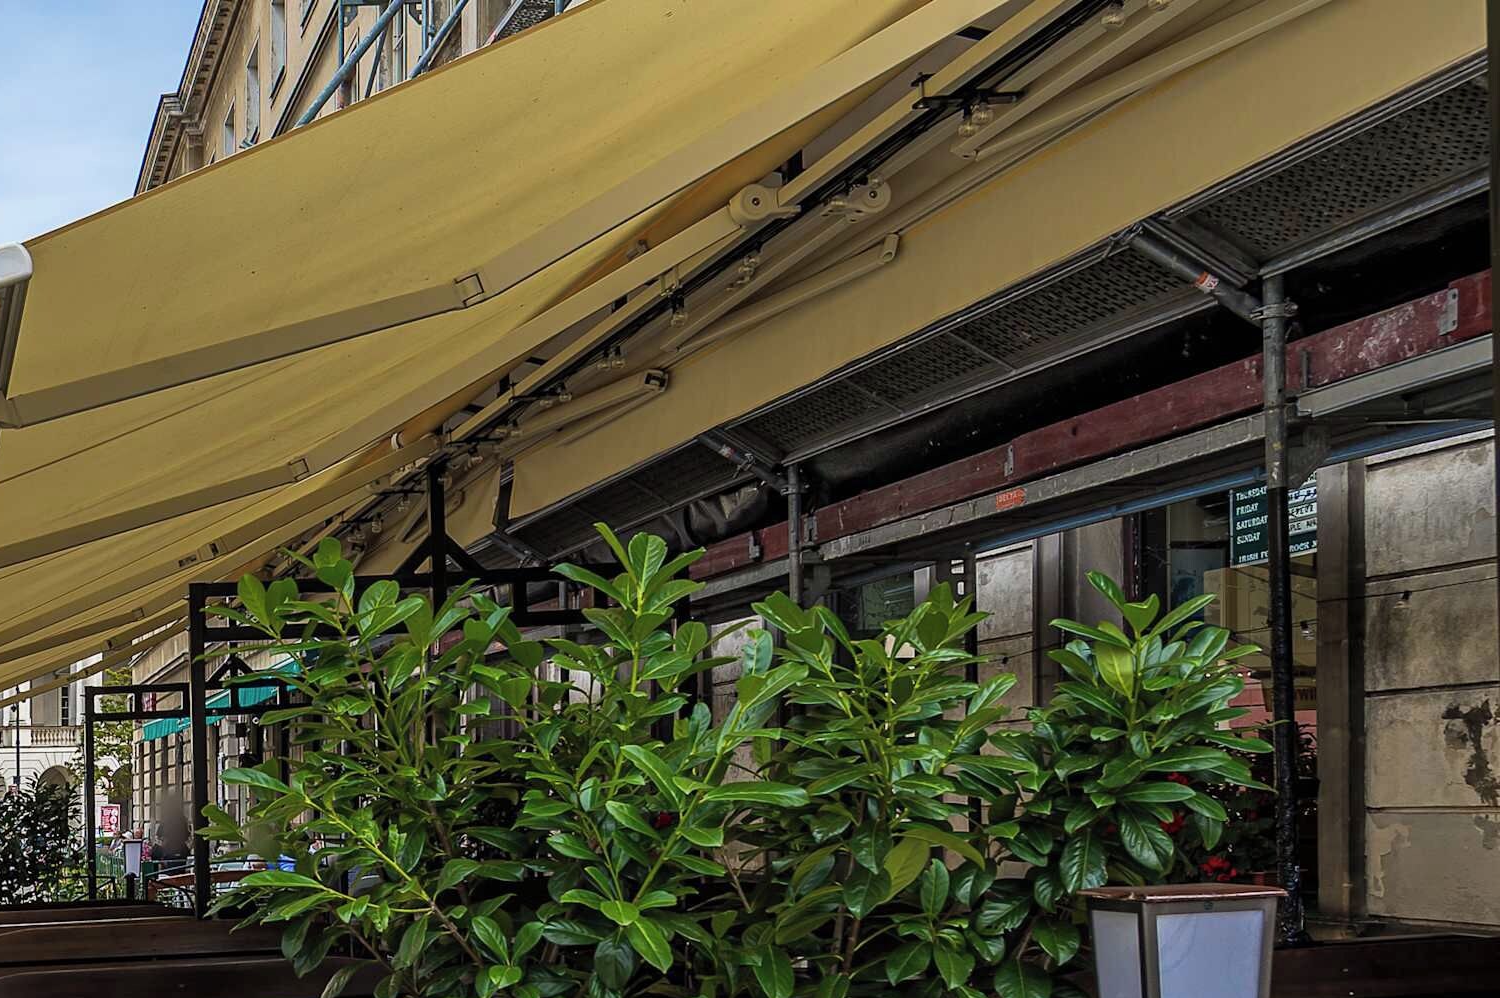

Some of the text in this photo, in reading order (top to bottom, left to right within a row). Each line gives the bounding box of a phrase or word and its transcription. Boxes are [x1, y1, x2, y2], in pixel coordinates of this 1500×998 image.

[1236, 502, 1258, 515] FRIDAY
[1235, 515, 1268, 531] SATURDAY
[1236, 532, 1260, 545] SUNDAY
[1239, 552, 1258, 563] IRISH
